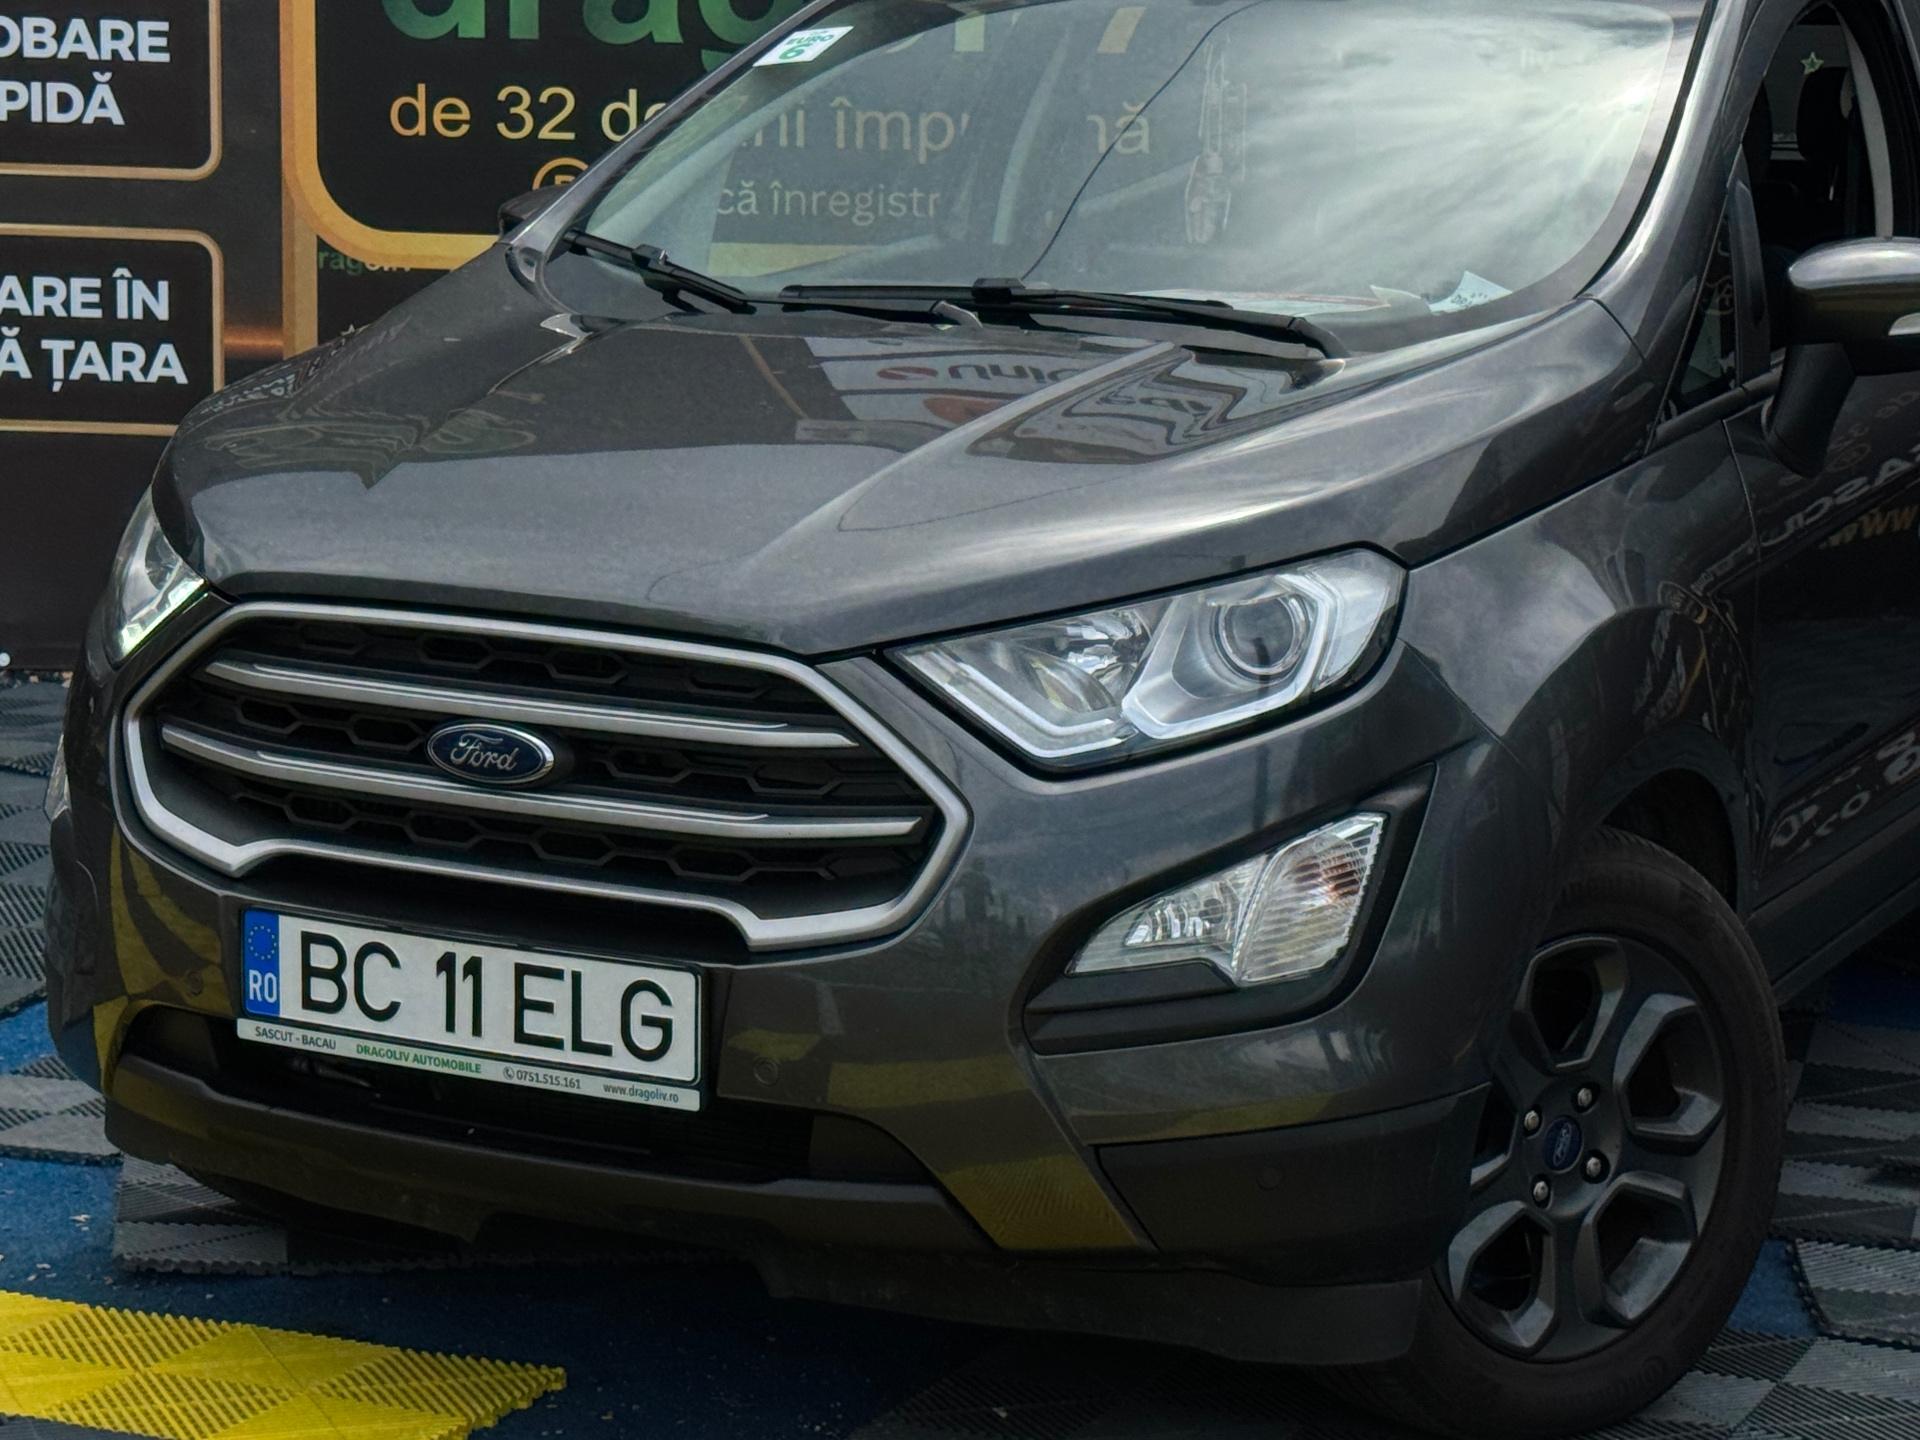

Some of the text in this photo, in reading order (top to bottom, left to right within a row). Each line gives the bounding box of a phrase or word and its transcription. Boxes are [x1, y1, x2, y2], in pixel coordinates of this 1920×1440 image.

[778, 42, 815, 59] 6
[784, 34, 834, 46] EURO
[0, 71, 125, 125] PIDĂ
[389, 83, 471, 139] de
[496, 86, 576, 141] 32
[601, 89, 668, 142] d
[0, 267, 170, 321] ARE ÎN
[40, 339, 189, 392] ȚARA
[450, 732, 520, 771] Ford
[249, 930, 674, 1062] RO BC 11 ELG
[255, 1025, 295, 1042] SASCUT
[302, 1034, 337, 1050] BACAU
[356, 1044, 411, 1063] DRAGOLIV
[412, 1052, 482, 1074] AUTOMOBILE
[516, 1069, 582, 1090] 0751.515.161
[602, 1082, 680, 1103] www.dragoliv.ro
